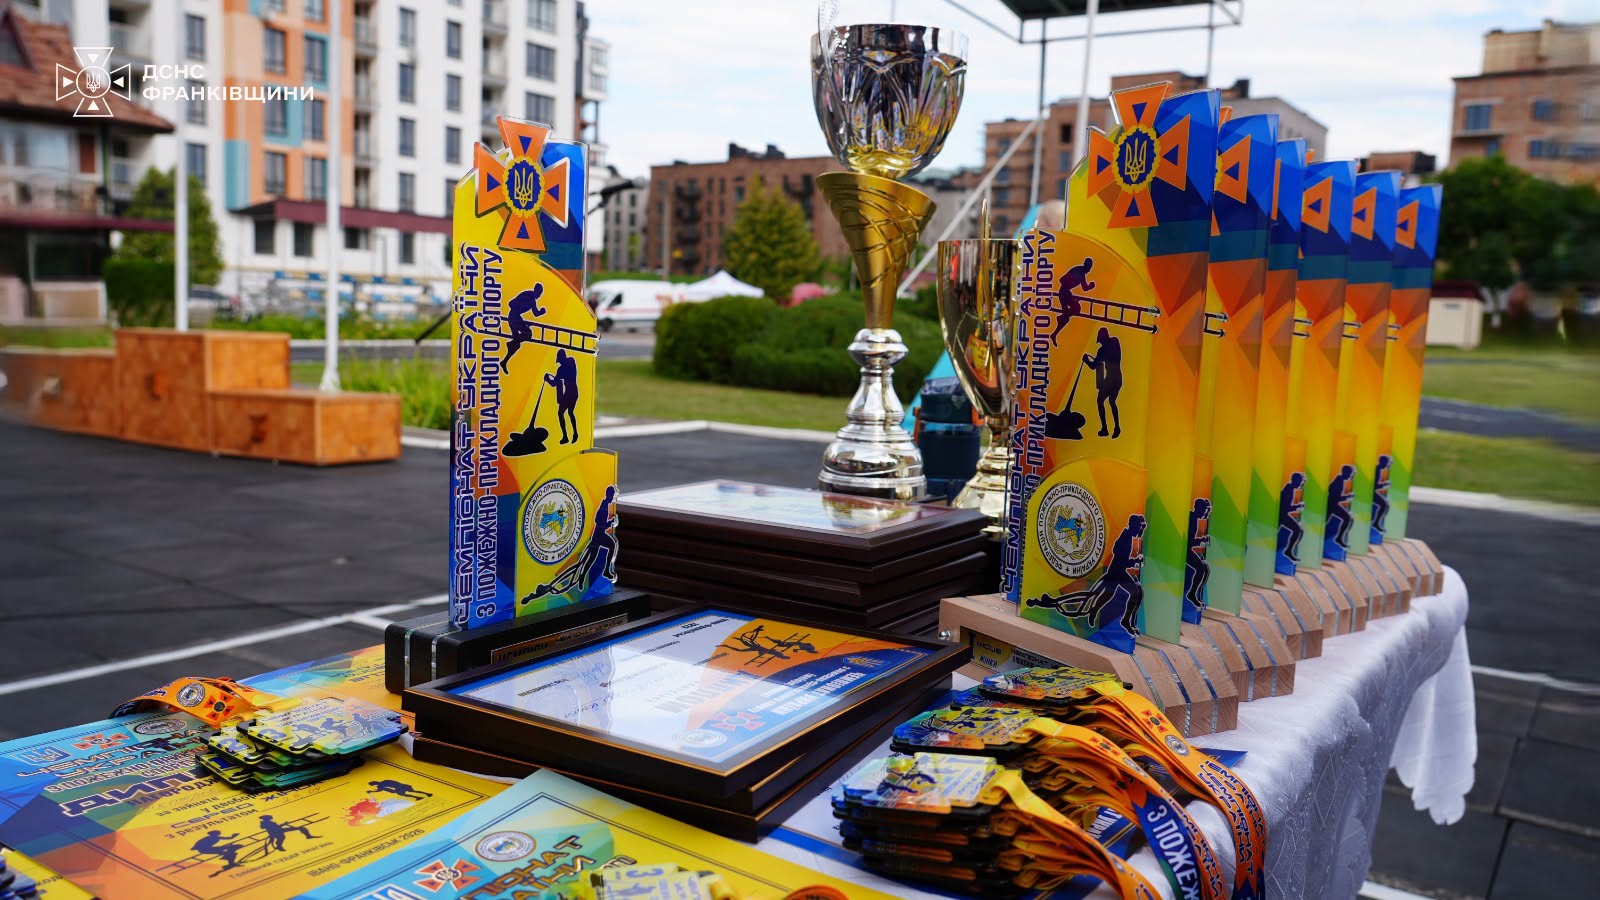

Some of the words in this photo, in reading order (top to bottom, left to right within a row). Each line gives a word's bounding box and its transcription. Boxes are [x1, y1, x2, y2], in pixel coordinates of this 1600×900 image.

[481, 248, 503, 334] СПОРТУ
[1035, 230, 1057, 311] СПОРТУ
[458, 245, 480, 410] УКРАЇНИ
[1003, 403, 1026, 594] ЧЕМПІОНАТ
[1015, 233, 1036, 391] УКРАЇНИ
[476, 337, 501, 600] ПОЖЕЖНО-ПРИКЛАДНОГО
[455, 422, 476, 624] ЧЕМПІОНАТ
[1039, 484, 1099, 527] ПОЖЕЖНО-ПРИКЛАДНОГО
[476, 602, 497, 619] З
[59, 767, 205, 817] ДИП
[125, 776, 220, 807] НАГОРОДЖ
[176, 808, 259, 837] результатом
[1146, 804, 1168, 823] З
[306, 838, 398, 878] ІВАНО-ФРАНКІВСЬК
[1152, 818, 1200, 900] ПОЖЕЖ
